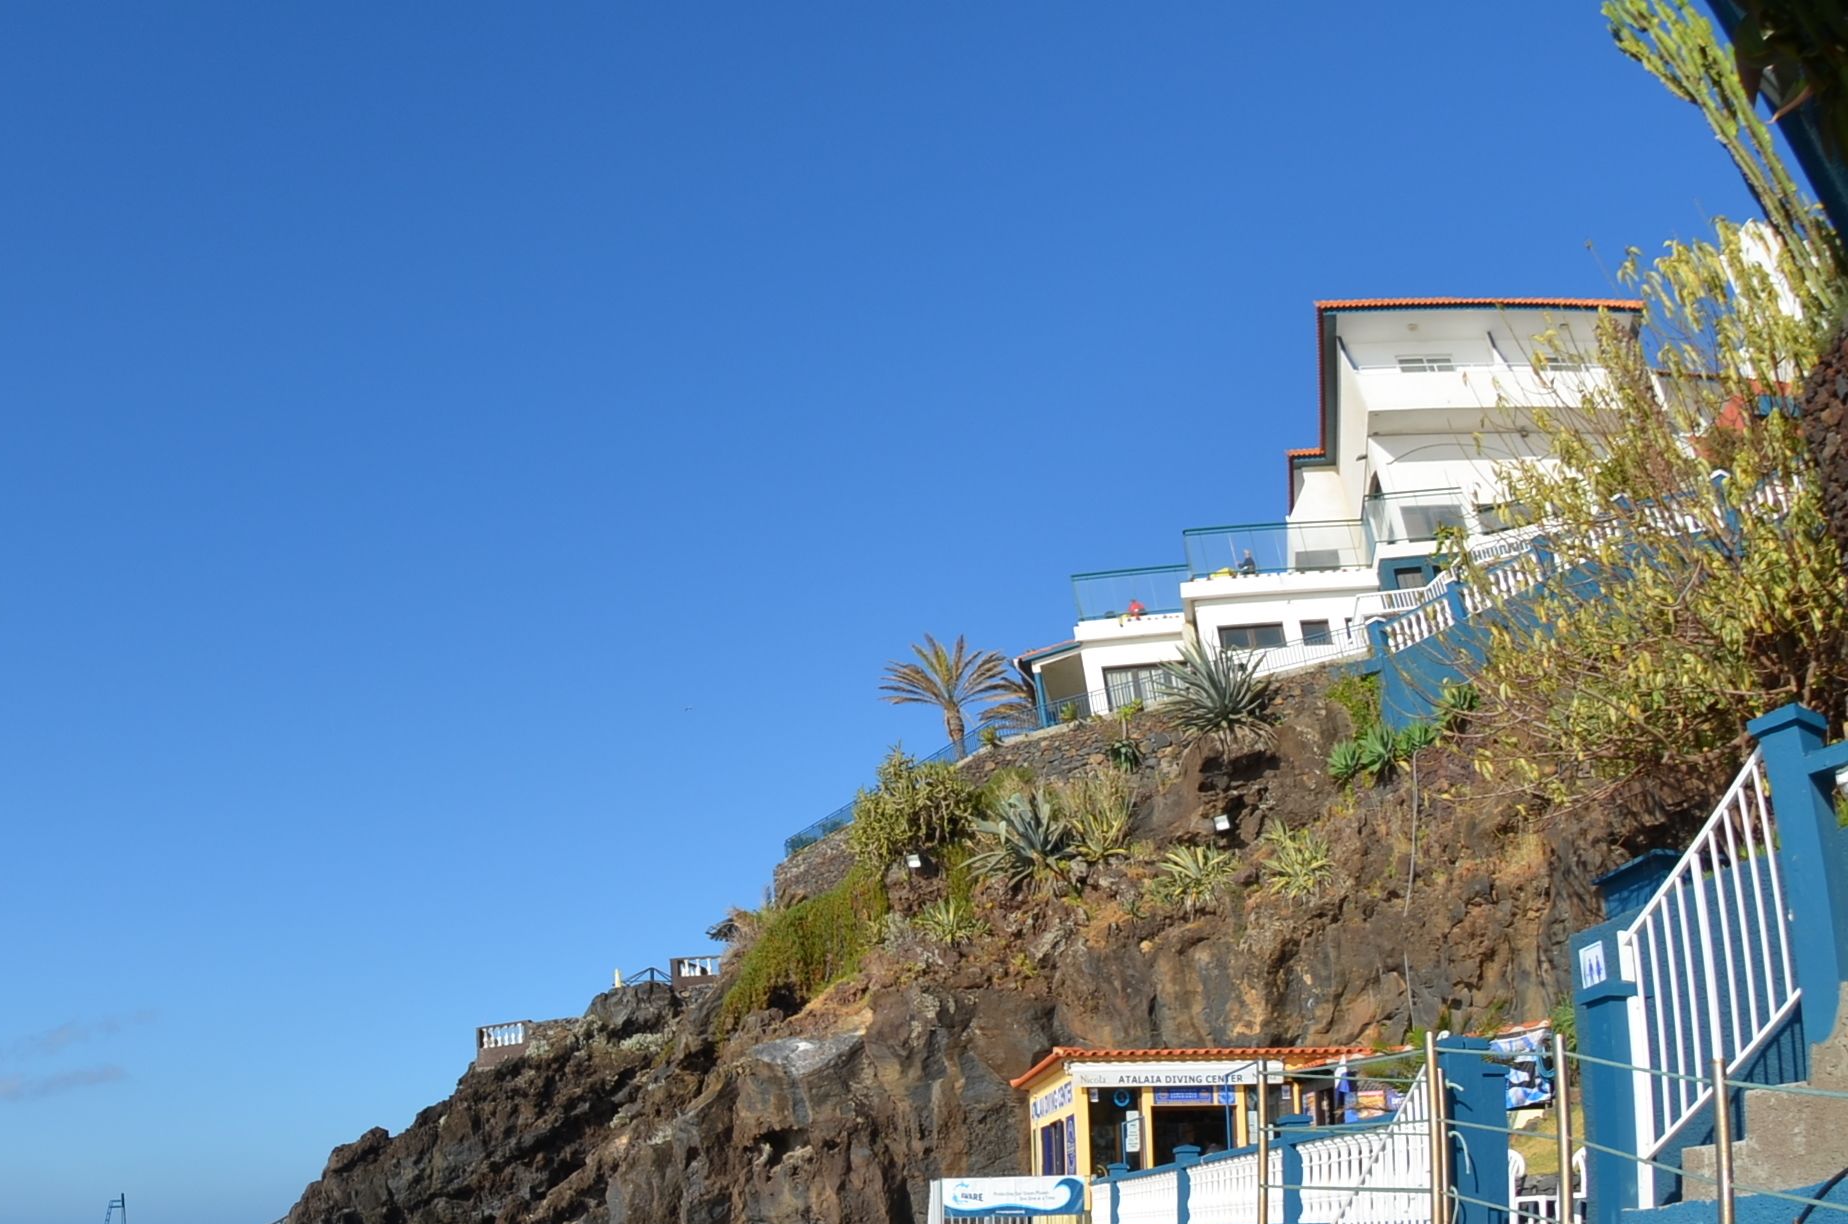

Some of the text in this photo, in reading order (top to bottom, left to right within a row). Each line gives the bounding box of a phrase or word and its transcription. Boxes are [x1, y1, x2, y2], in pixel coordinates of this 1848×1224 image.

[1118, 1075, 1161, 1084] ATALAIA
[1165, 1074, 1203, 1084] DIVING
[1205, 1074, 1243, 1084] CENER
